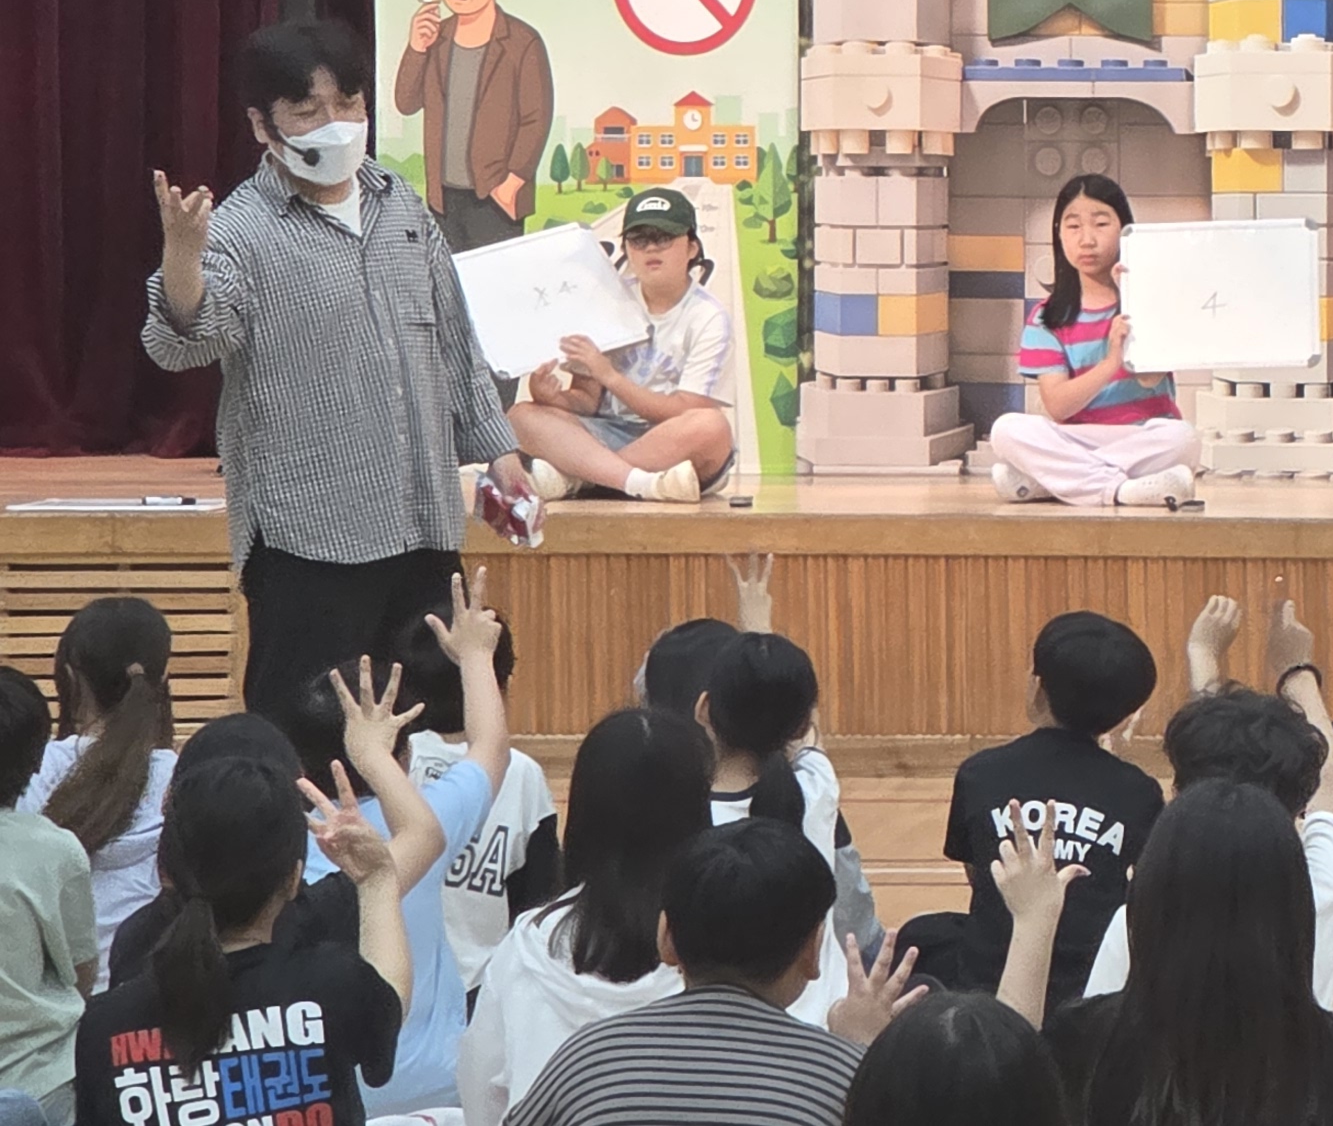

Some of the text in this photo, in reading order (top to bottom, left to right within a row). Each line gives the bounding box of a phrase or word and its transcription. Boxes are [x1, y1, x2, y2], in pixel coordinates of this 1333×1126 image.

[1201, 291, 1227, 318] 4
[991, 800, 1125, 856] KOREA
[111, 1001, 325, 1066] HWANG
